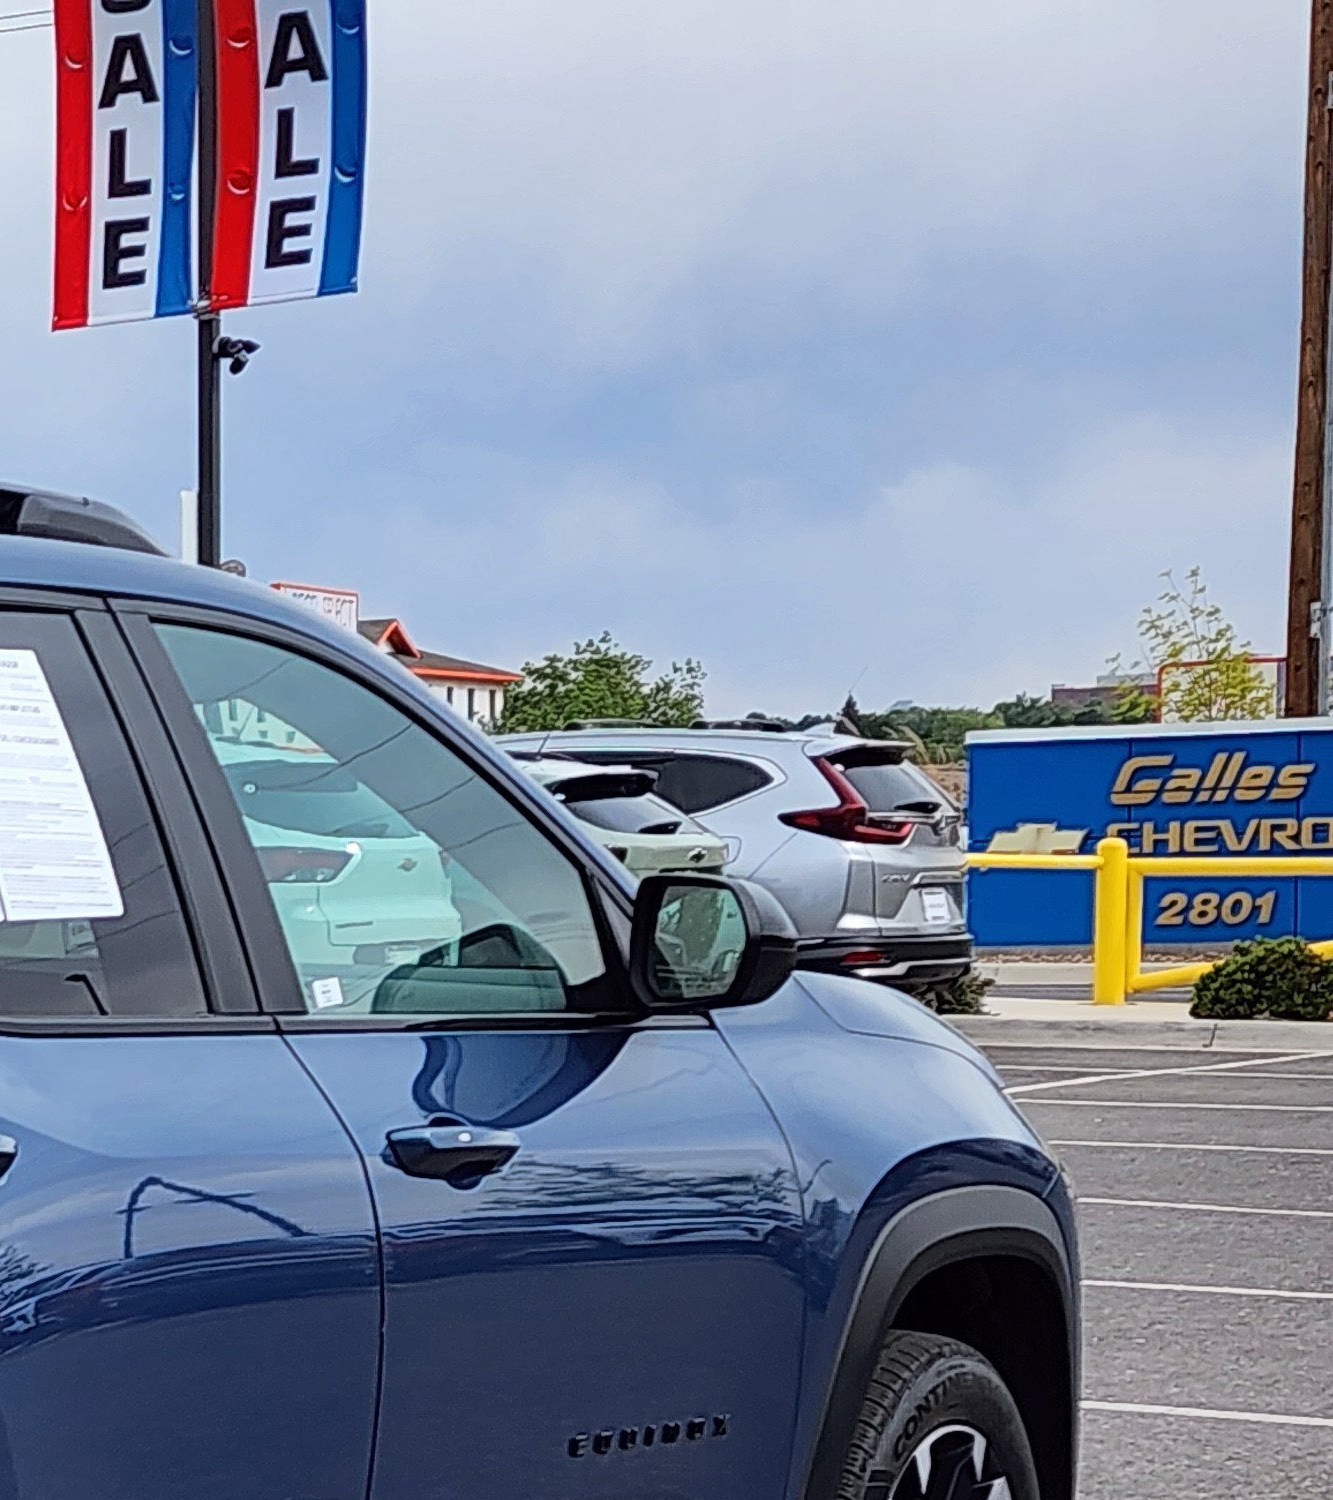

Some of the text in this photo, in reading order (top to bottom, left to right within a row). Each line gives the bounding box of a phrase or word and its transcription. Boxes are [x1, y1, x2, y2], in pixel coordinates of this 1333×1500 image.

[97, 0, 160, 290] ALE
[1110, 750, 1317, 806] Galles
[1154, 889, 1277, 926] 2801
